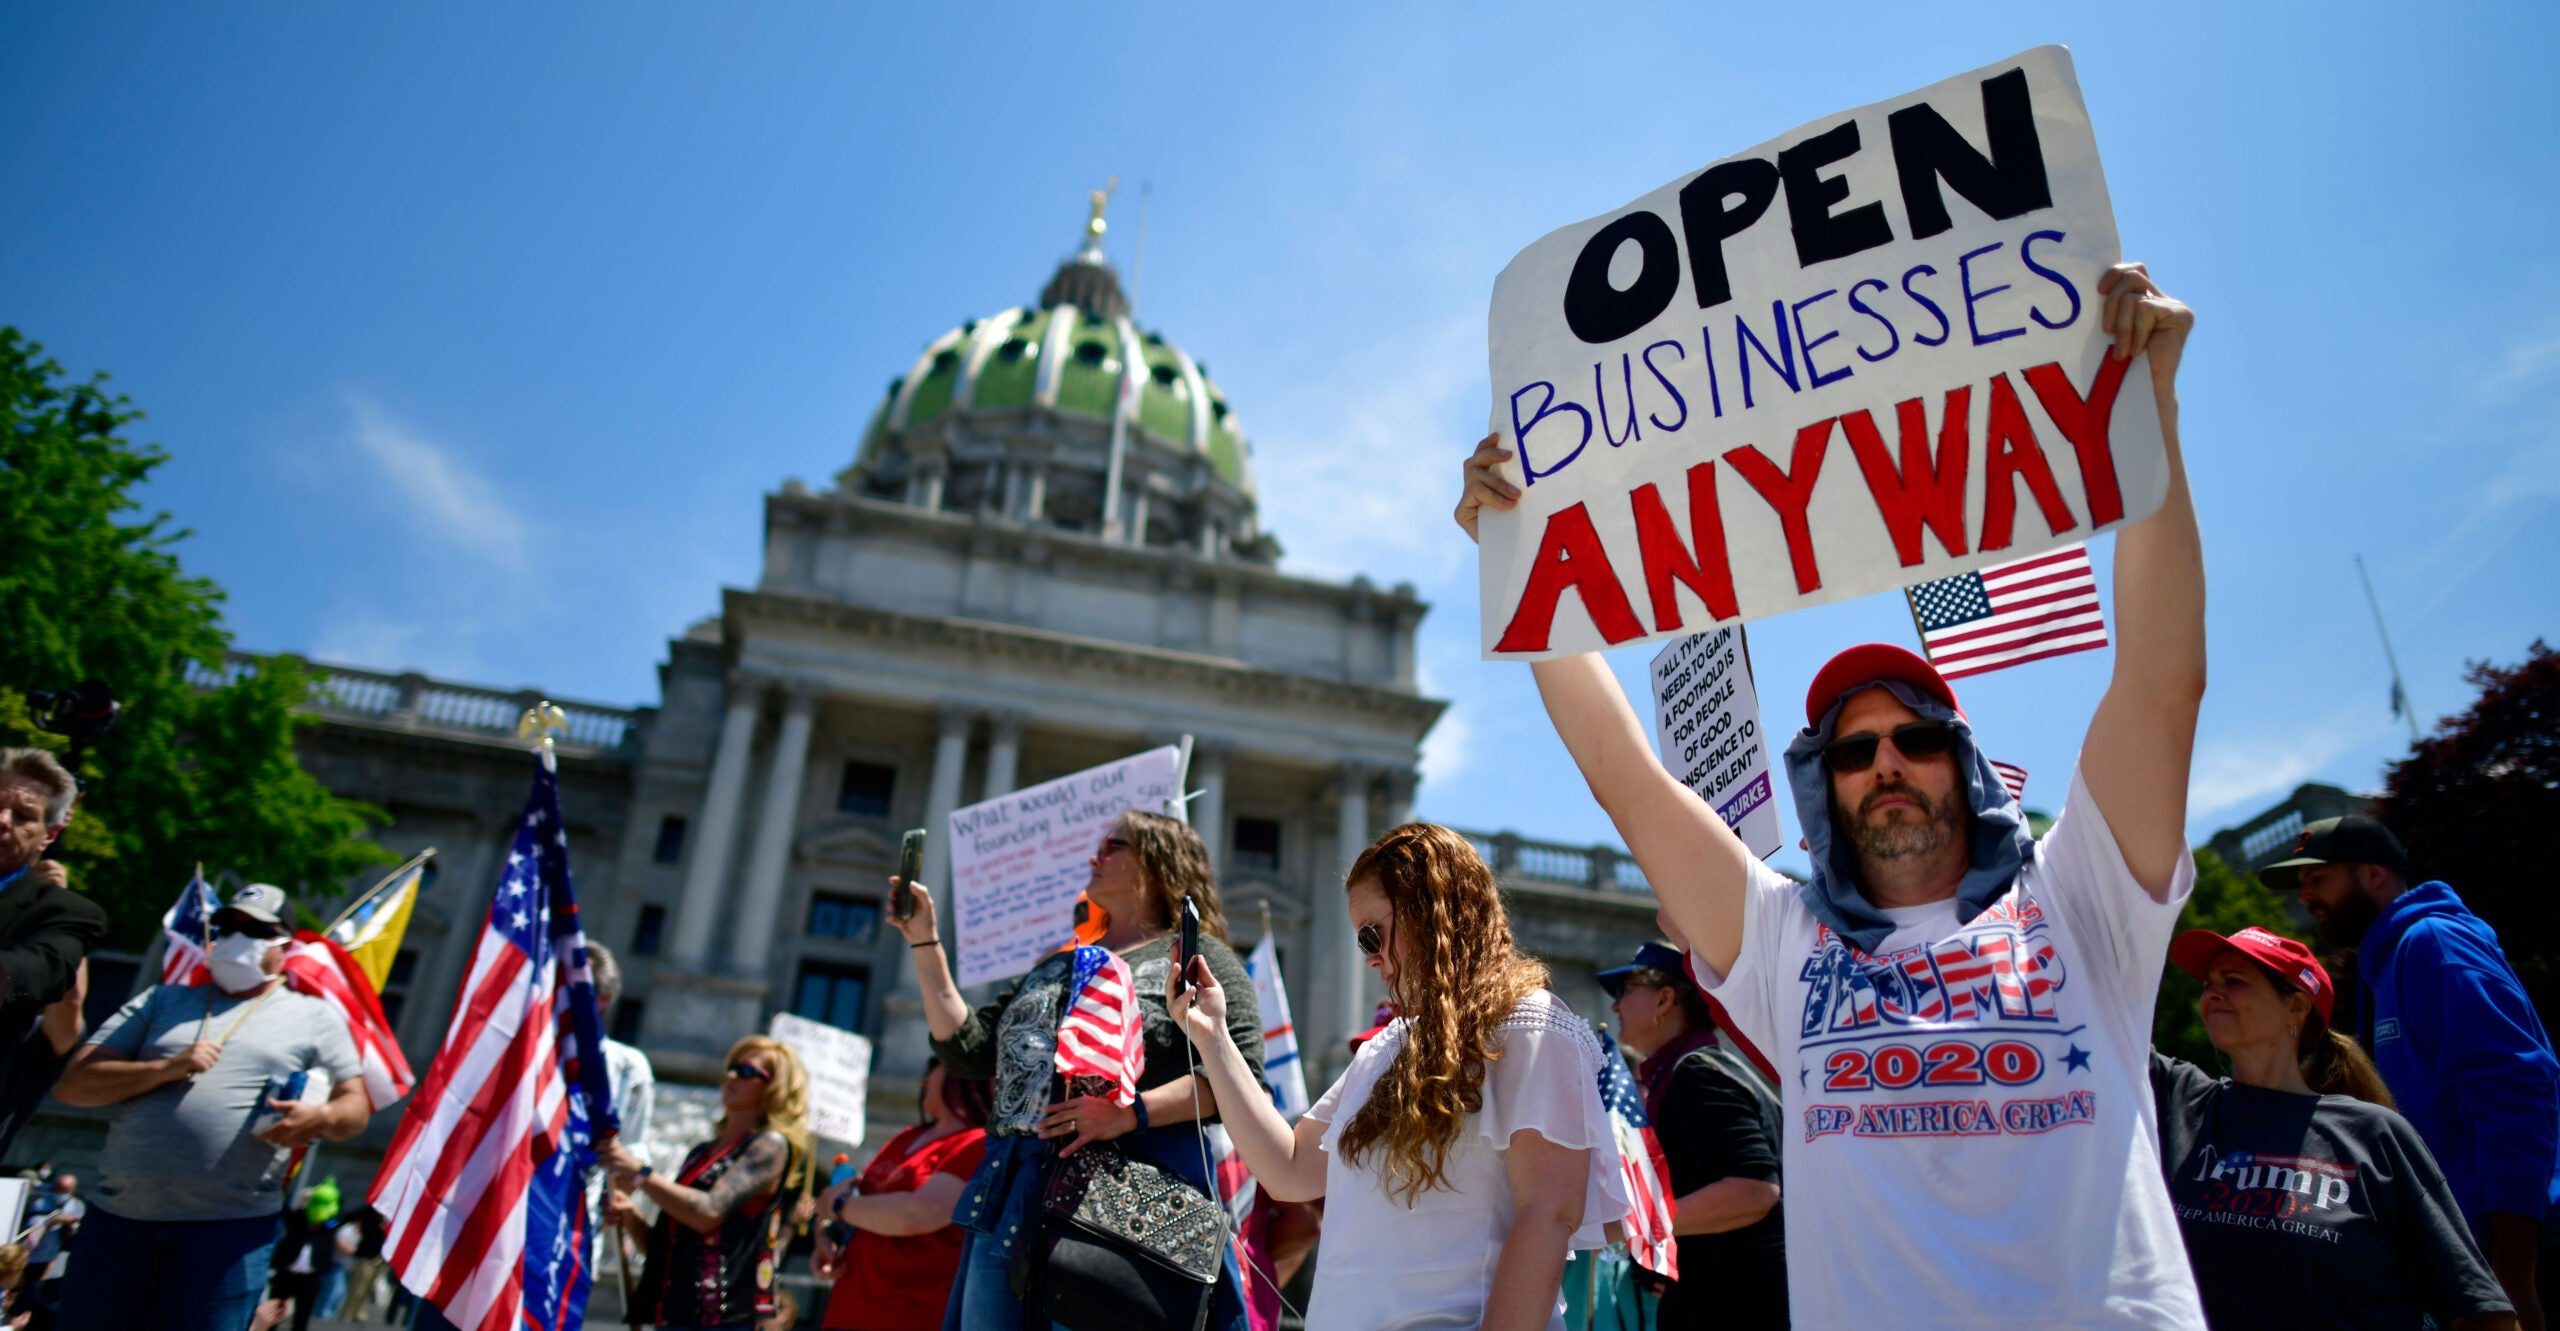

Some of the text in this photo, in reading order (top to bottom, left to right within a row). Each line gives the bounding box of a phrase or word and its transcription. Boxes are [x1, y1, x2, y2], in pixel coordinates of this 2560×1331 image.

[1563, 67, 2053, 345] OPEN
[1510, 230, 2082, 487] BUSINESSES
[1492, 343, 2131, 653] ANYWAY
[1661, 626, 1732, 707] NEEDS TO GAIN
[1680, 631, 1709, 660] TYRA
[1664, 648, 1735, 731] A FOOTHOLD IS
[1673, 678, 1735, 748] FOR PEOPLE
[1684, 721, 1732, 764] OF GOOD
[1738, 719, 1755, 744] TO
[952, 765, 1129, 838] What would our
[1728, 780, 1767, 823] BURKE
[973, 817, 1051, 858] founding
[1799, 933, 2067, 1039] TRUMP
[1824, 1039, 2045, 1092] 2020
[1857, 1101, 1999, 1134] AMERICA
[2192, 1144, 2351, 1211] Trump
[2208, 1183, 2298, 1219] 2020
[2201, 1210, 2278, 1231] AMERICA
[2281, 1219, 2343, 1245] GREAT
